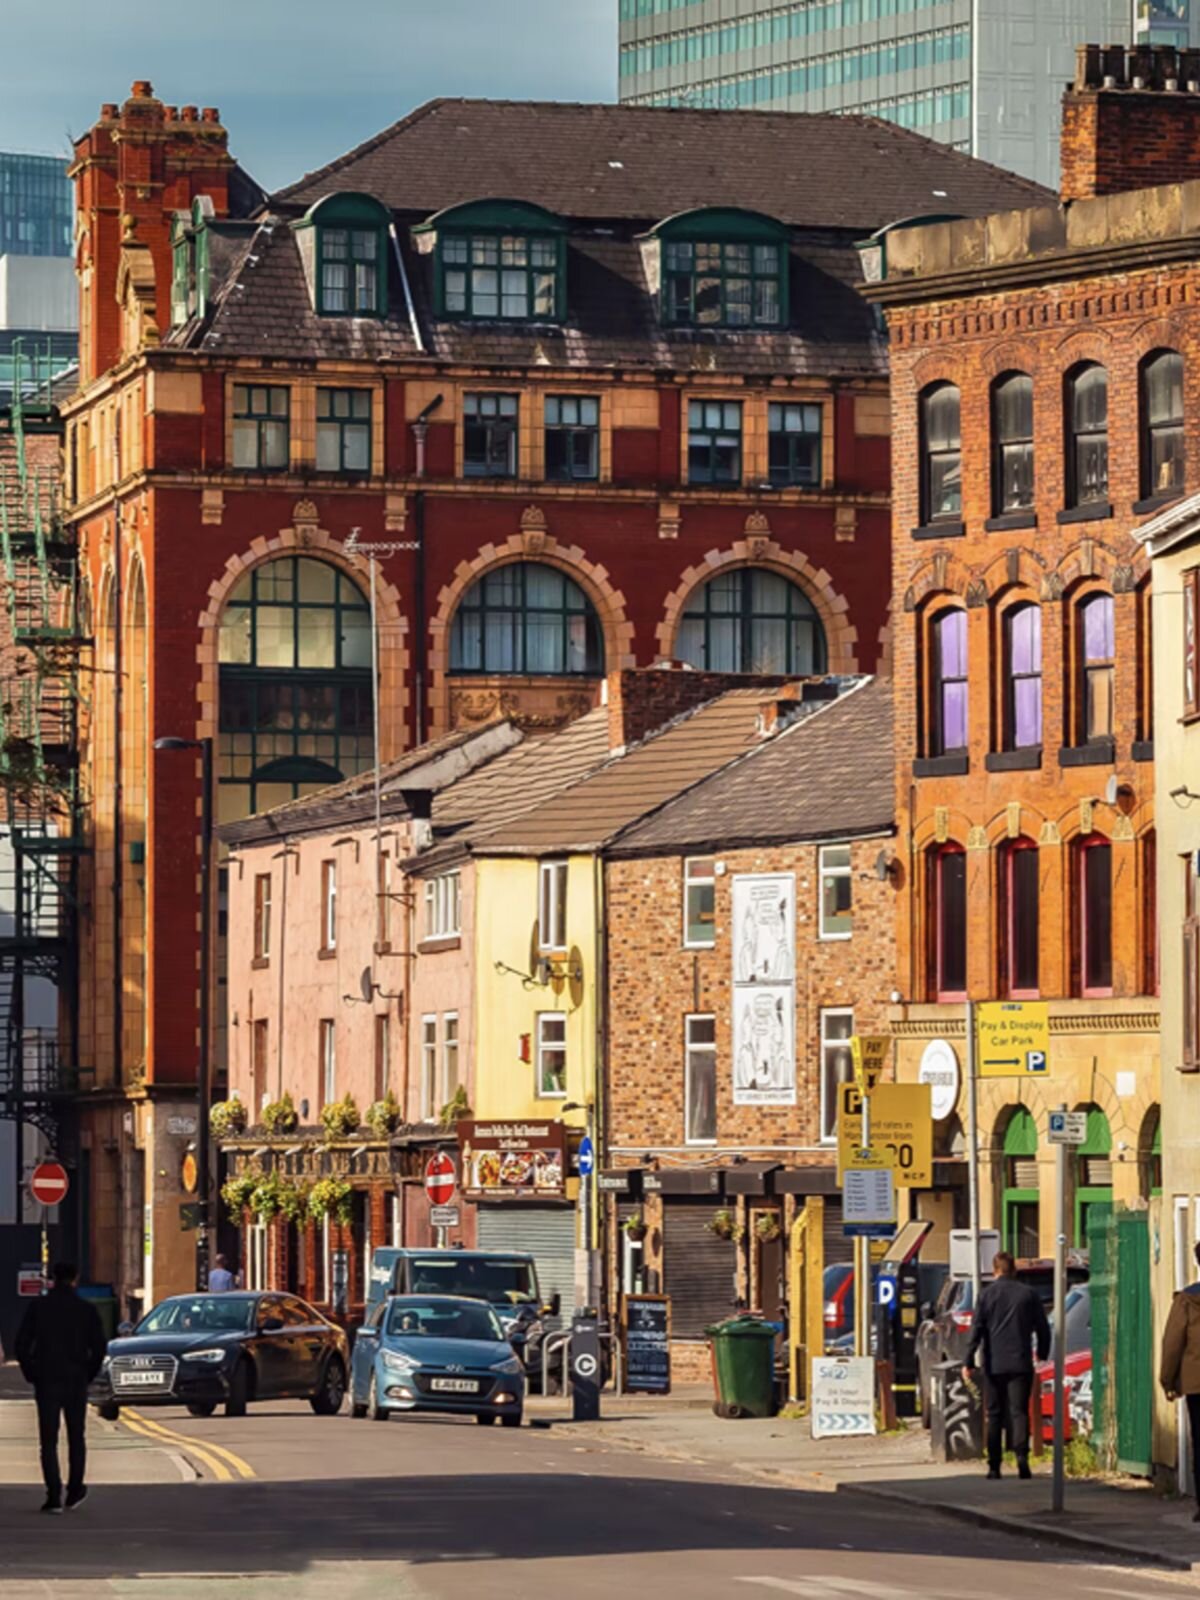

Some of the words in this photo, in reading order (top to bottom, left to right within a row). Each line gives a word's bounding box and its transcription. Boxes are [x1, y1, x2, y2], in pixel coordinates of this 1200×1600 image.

[981, 1021, 998, 1032] Pay
[1000, 1021, 1007, 1030] &
[1009, 1020, 1044, 1032] Display
[991, 1036, 1008, 1046] Car
[1011, 1035, 1034, 1046] Park
[866, 1041, 882, 1053] PAY
[862, 1057, 883, 1069] HERE
[1028, 1050, 1045, 1072] P
